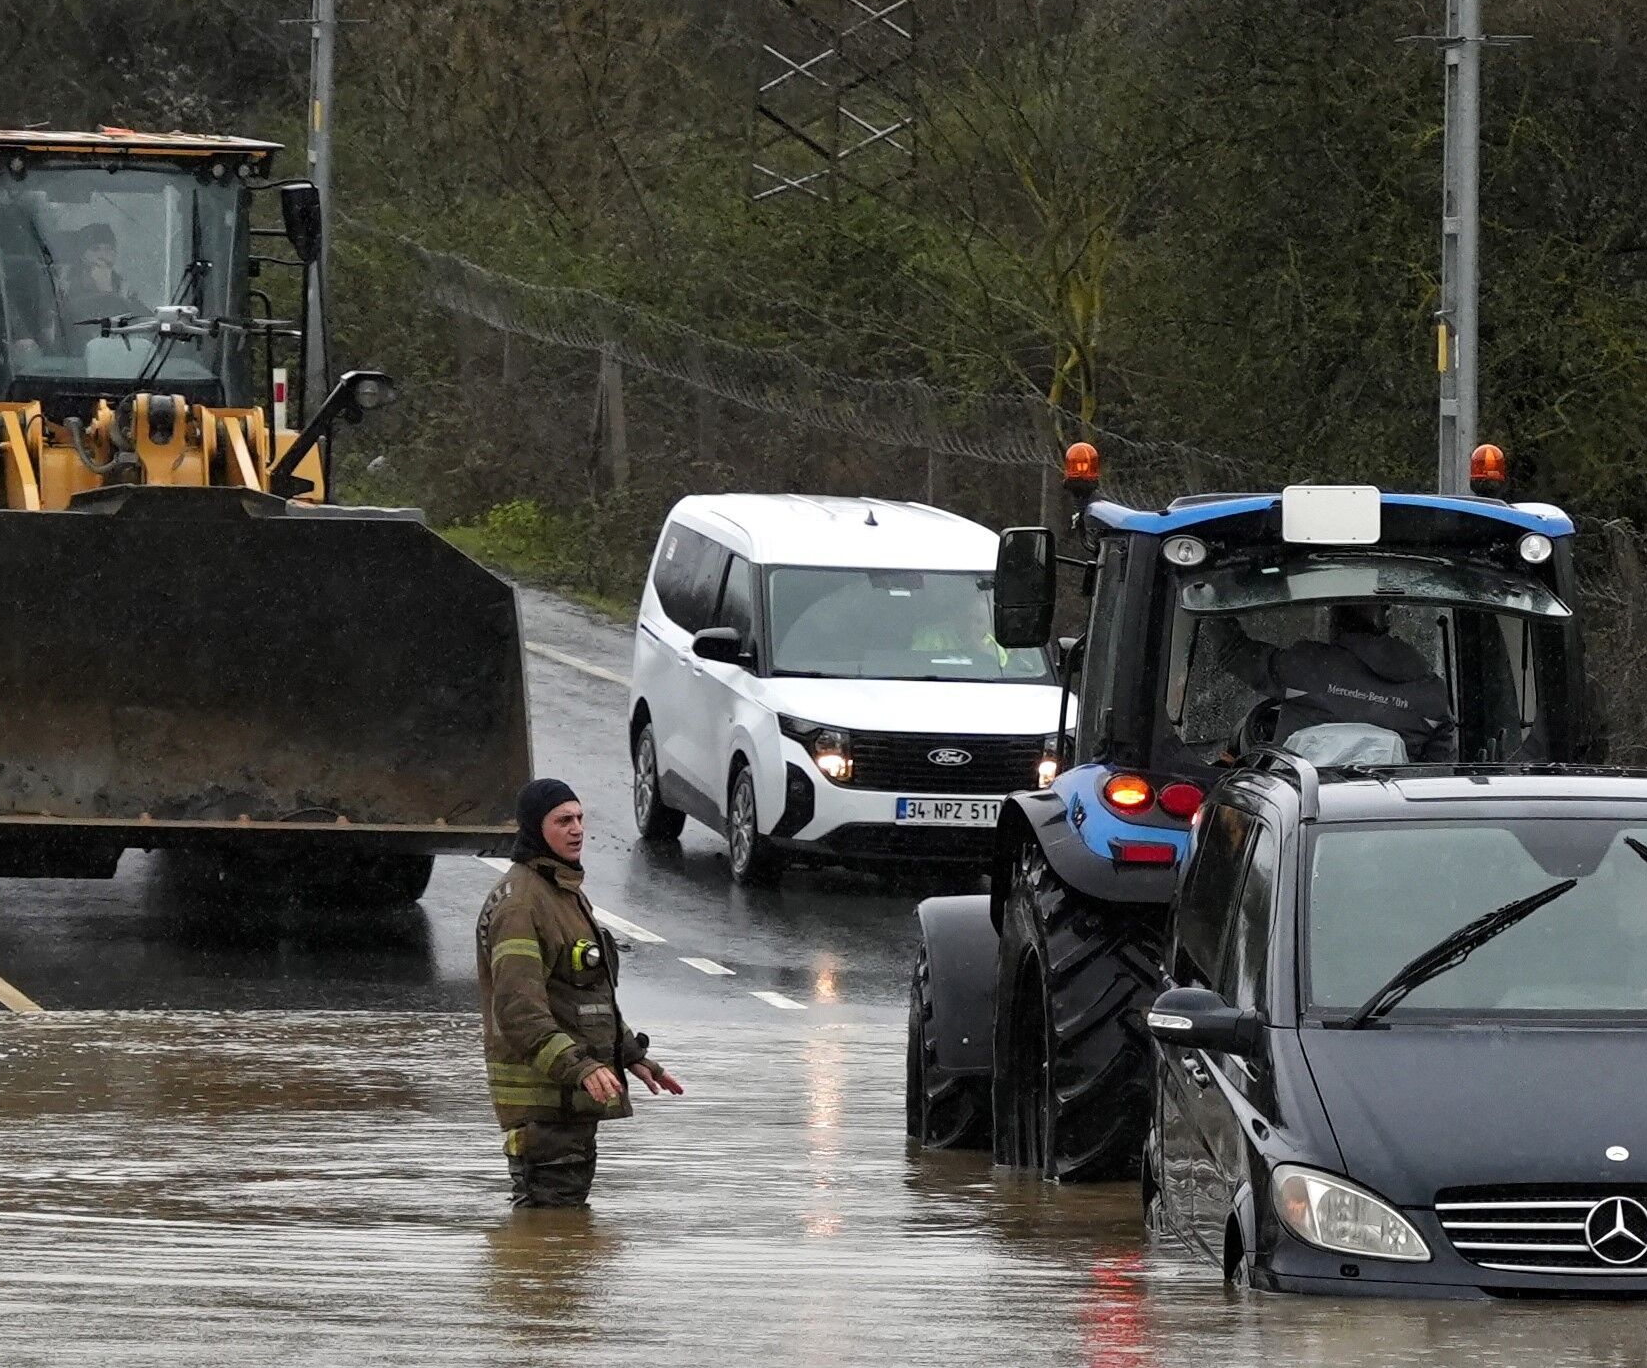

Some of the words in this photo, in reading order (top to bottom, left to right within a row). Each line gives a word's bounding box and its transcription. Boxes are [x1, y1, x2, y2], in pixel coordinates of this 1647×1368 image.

[1326, 683, 1389, 704] Mercedes-Benz
[934, 749, 965, 763] Ford
[907, 802, 926, 819] 34
[934, 802, 963, 820] NPZ
[971, 803, 998, 821] 511
